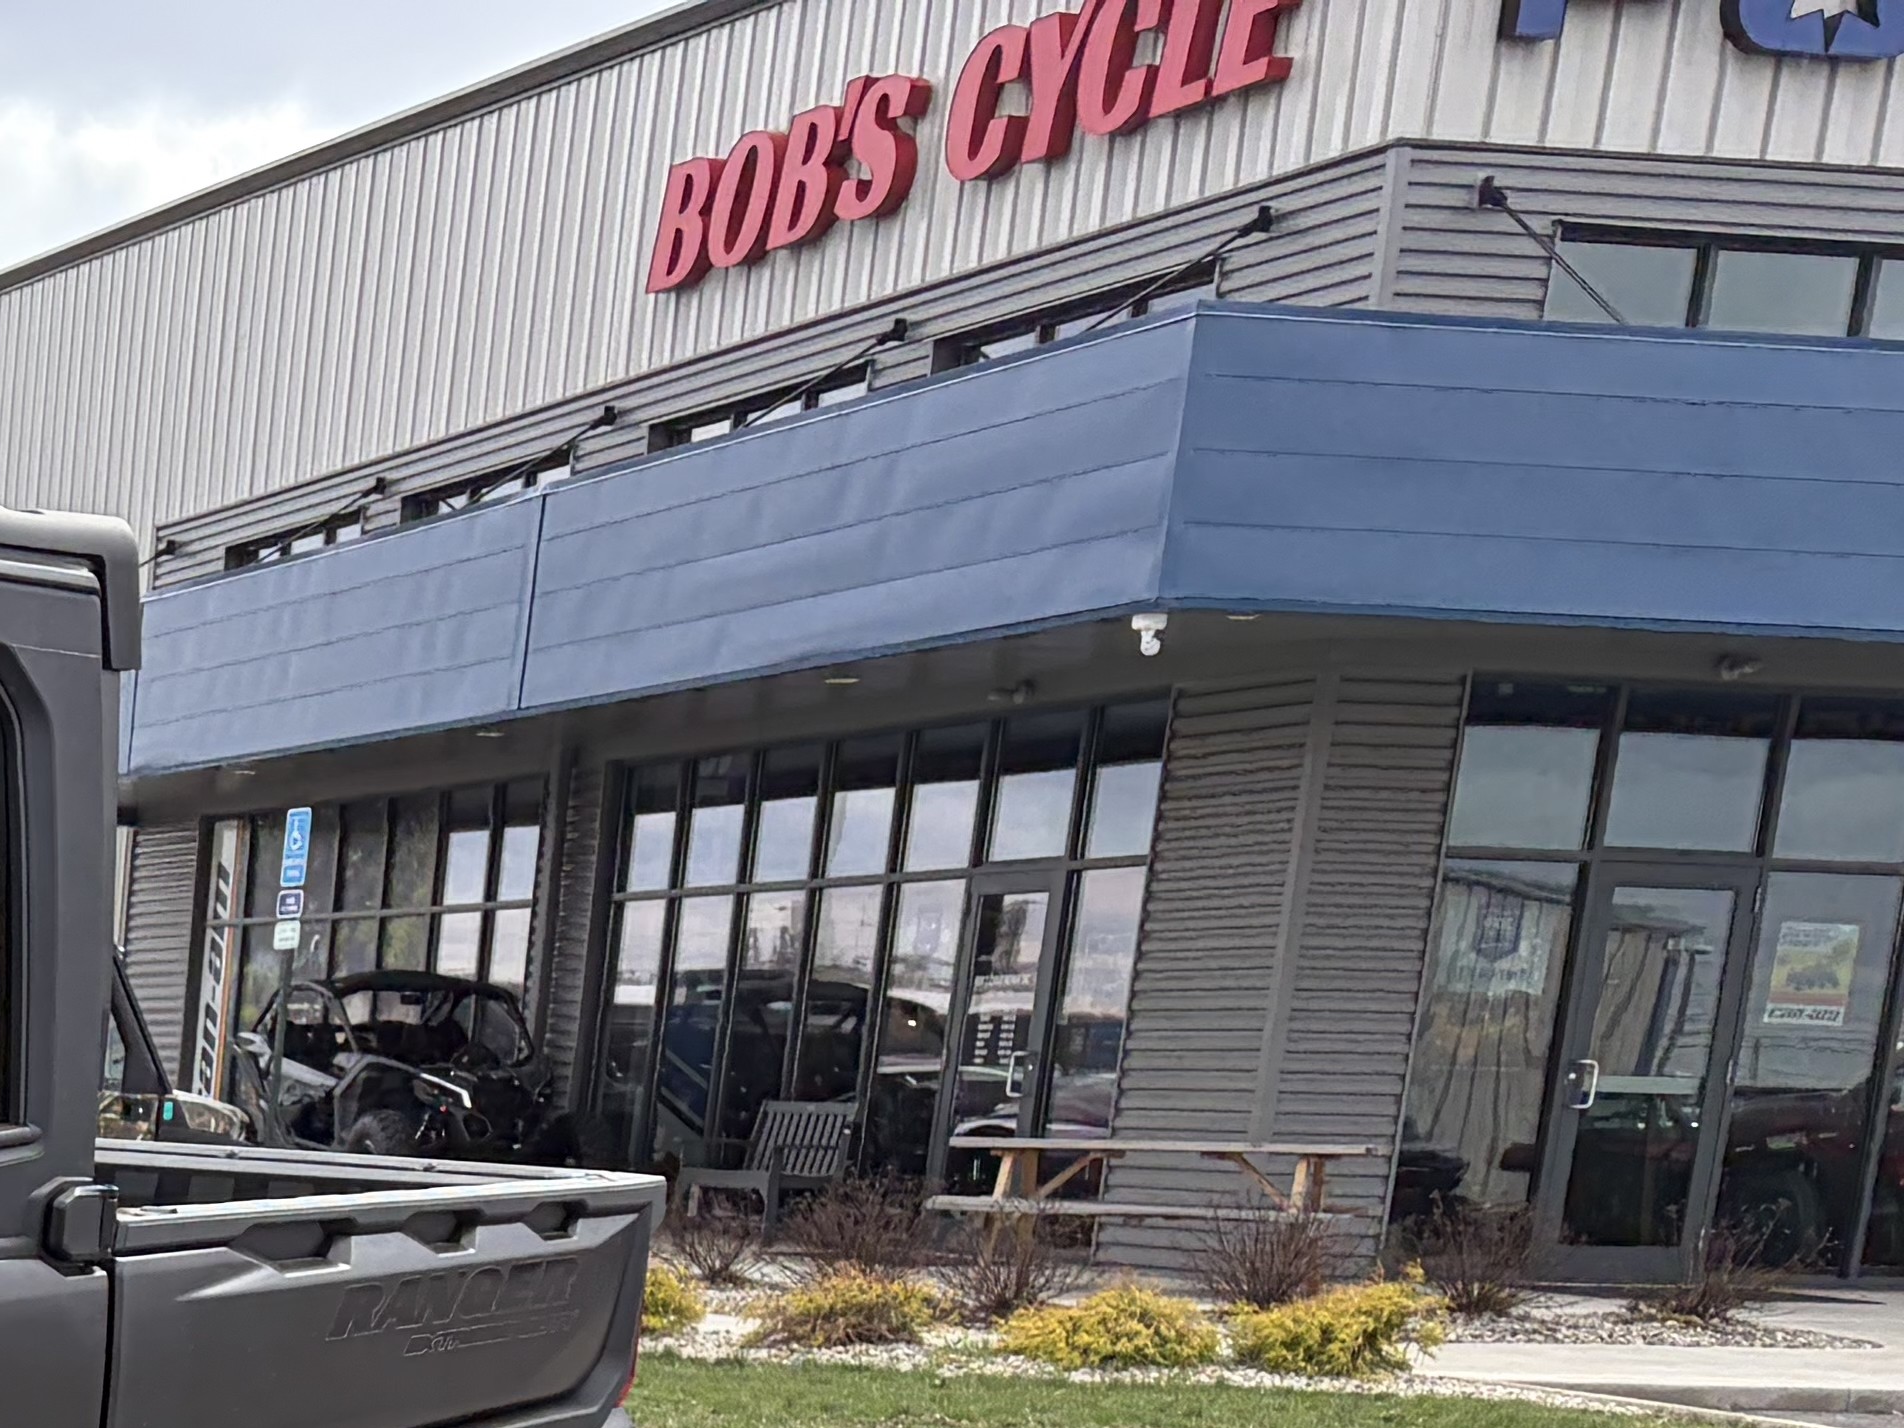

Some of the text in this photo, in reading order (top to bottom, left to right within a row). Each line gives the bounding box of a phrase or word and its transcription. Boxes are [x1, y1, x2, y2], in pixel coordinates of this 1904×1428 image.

[646, 0, 1294, 294] BOB'S CYCLE
[198, 861, 230, 1097] an-am
[325, 1254, 580, 1341] RANGER
